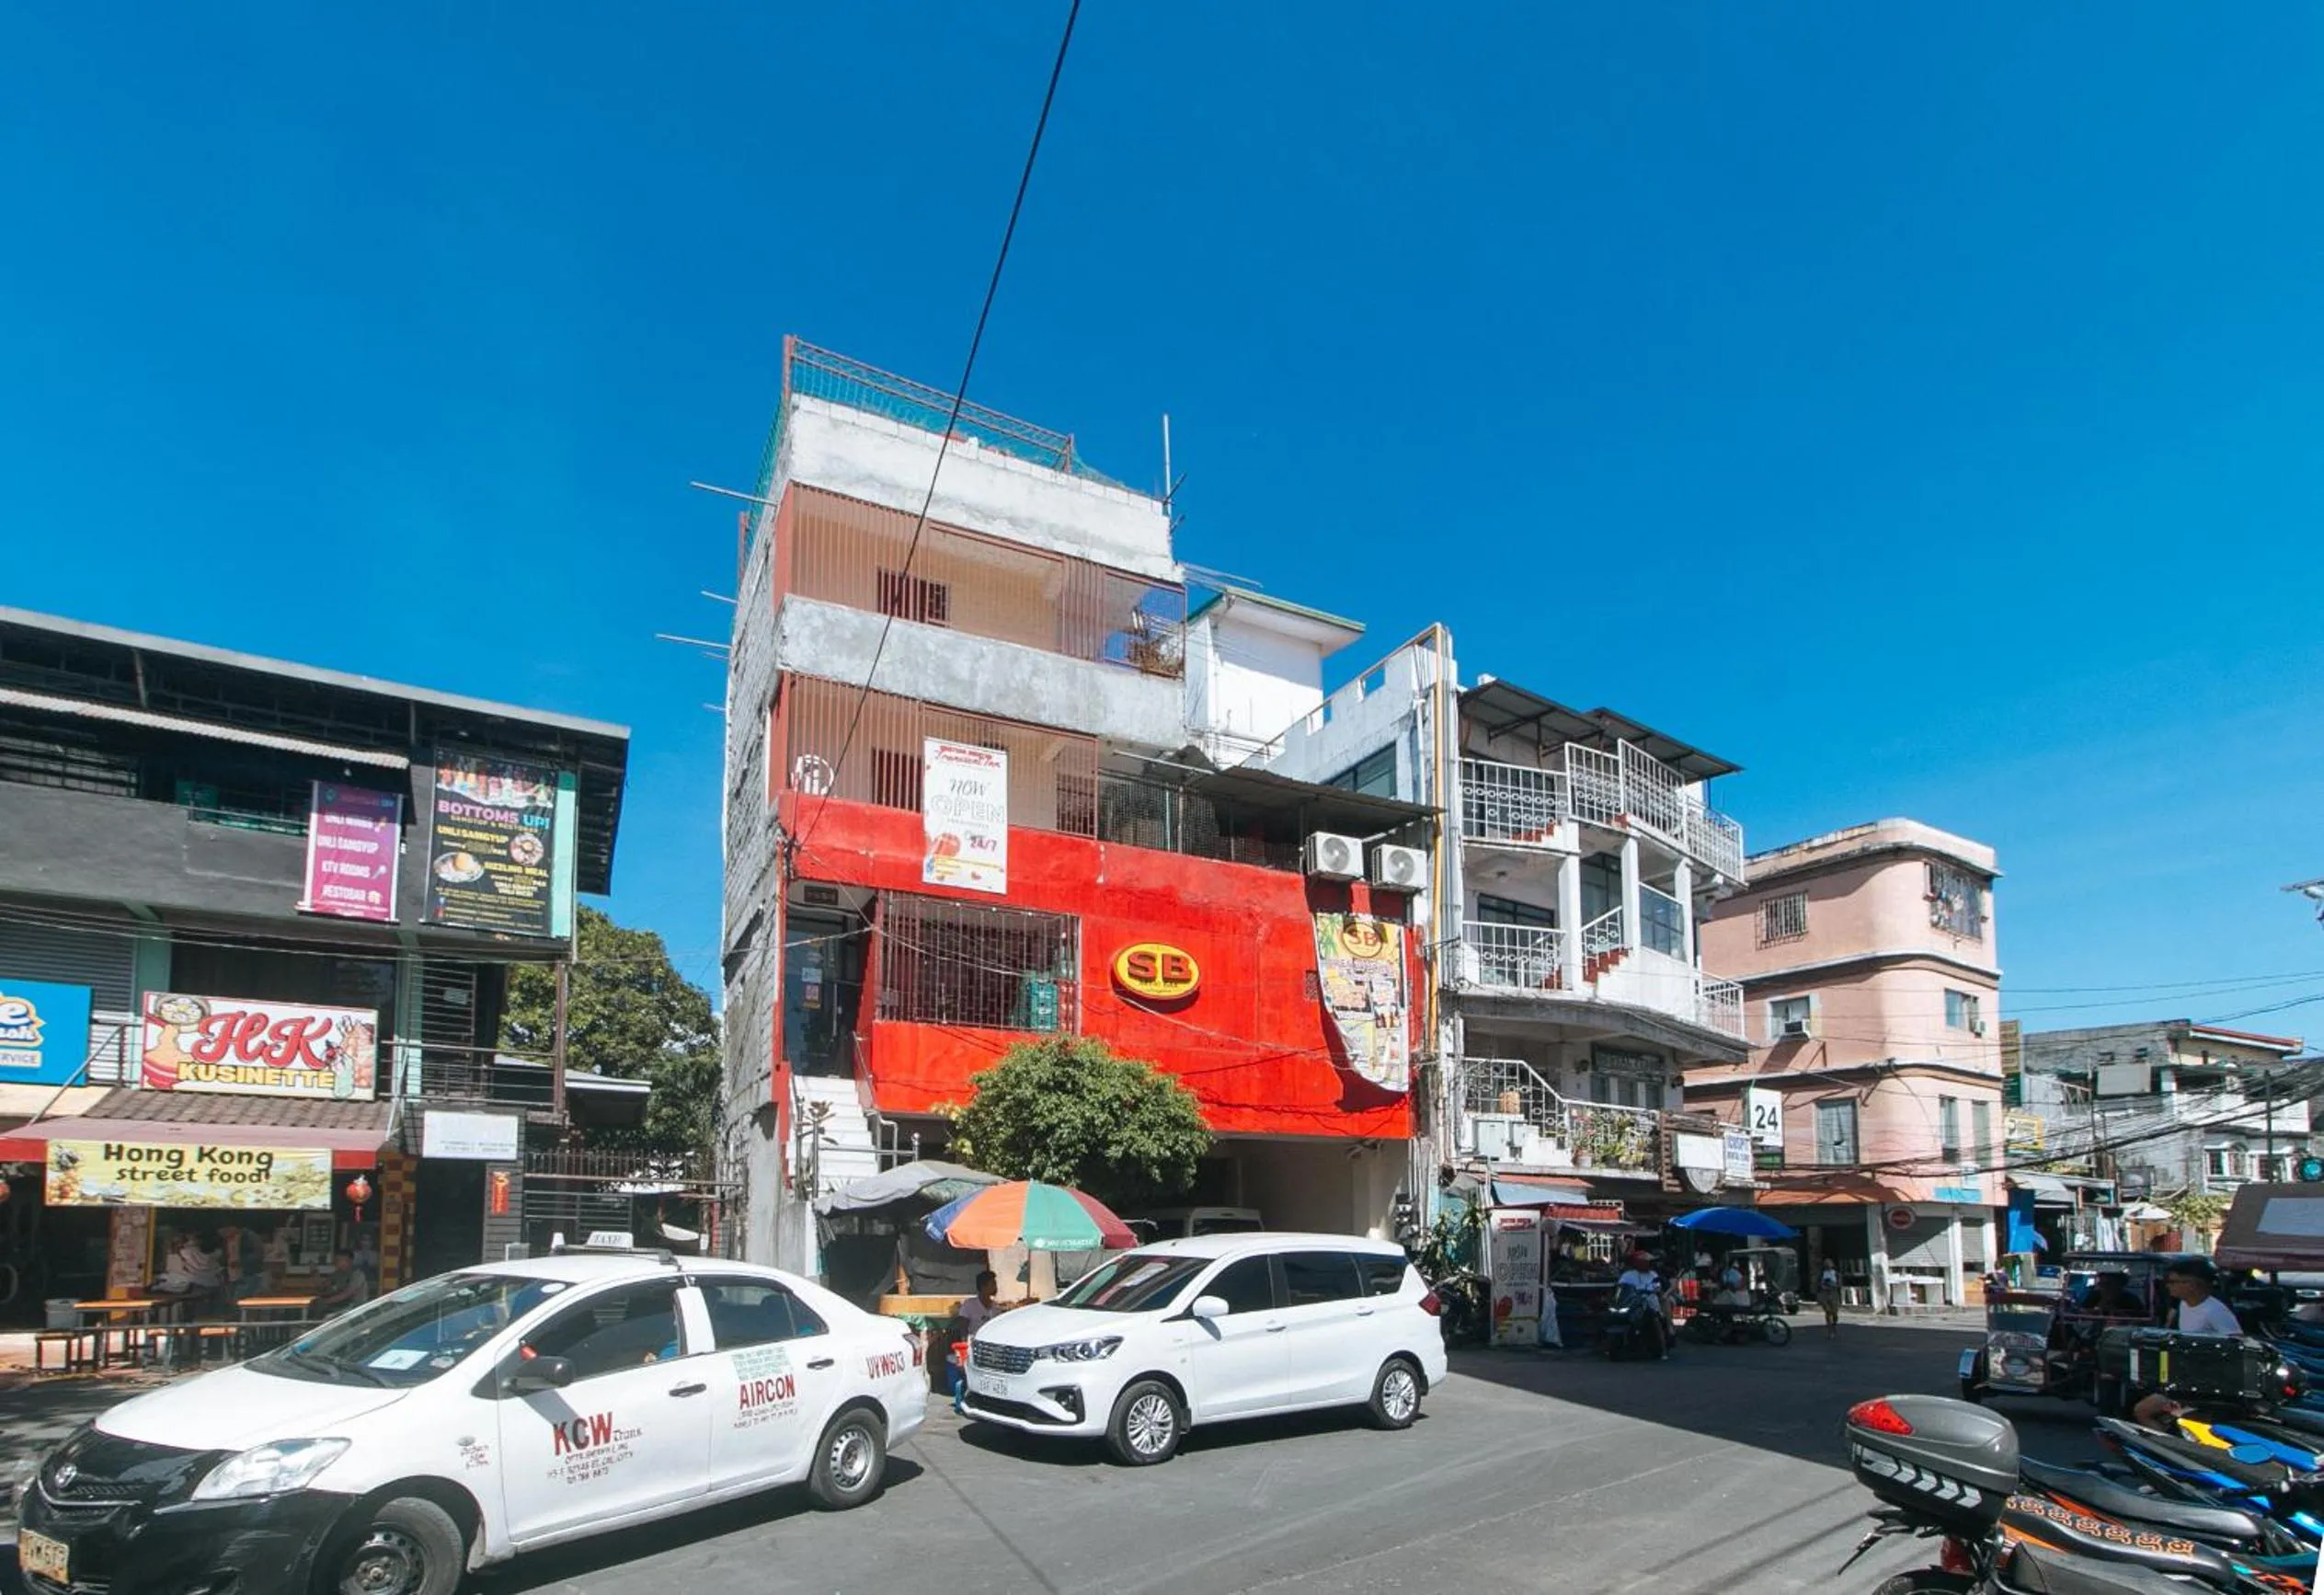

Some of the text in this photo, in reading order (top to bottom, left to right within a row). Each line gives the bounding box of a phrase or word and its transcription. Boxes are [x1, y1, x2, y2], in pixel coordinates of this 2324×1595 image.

[438, 799, 520, 824] BOTTOMS
[930, 794, 1005, 824] OPEN
[1128, 950, 1192, 984] SB
[190, 1010, 333, 1070] HK
[177, 1061, 337, 1089] KUSINETTE
[1755, 1105, 1779, 1130] 24
[103, 1142, 274, 1171] Hong Kong
[116, 1166, 199, 1183] street
[739, 1372, 796, 1411] AIRCON
[553, 1411, 613, 1457] KCW
